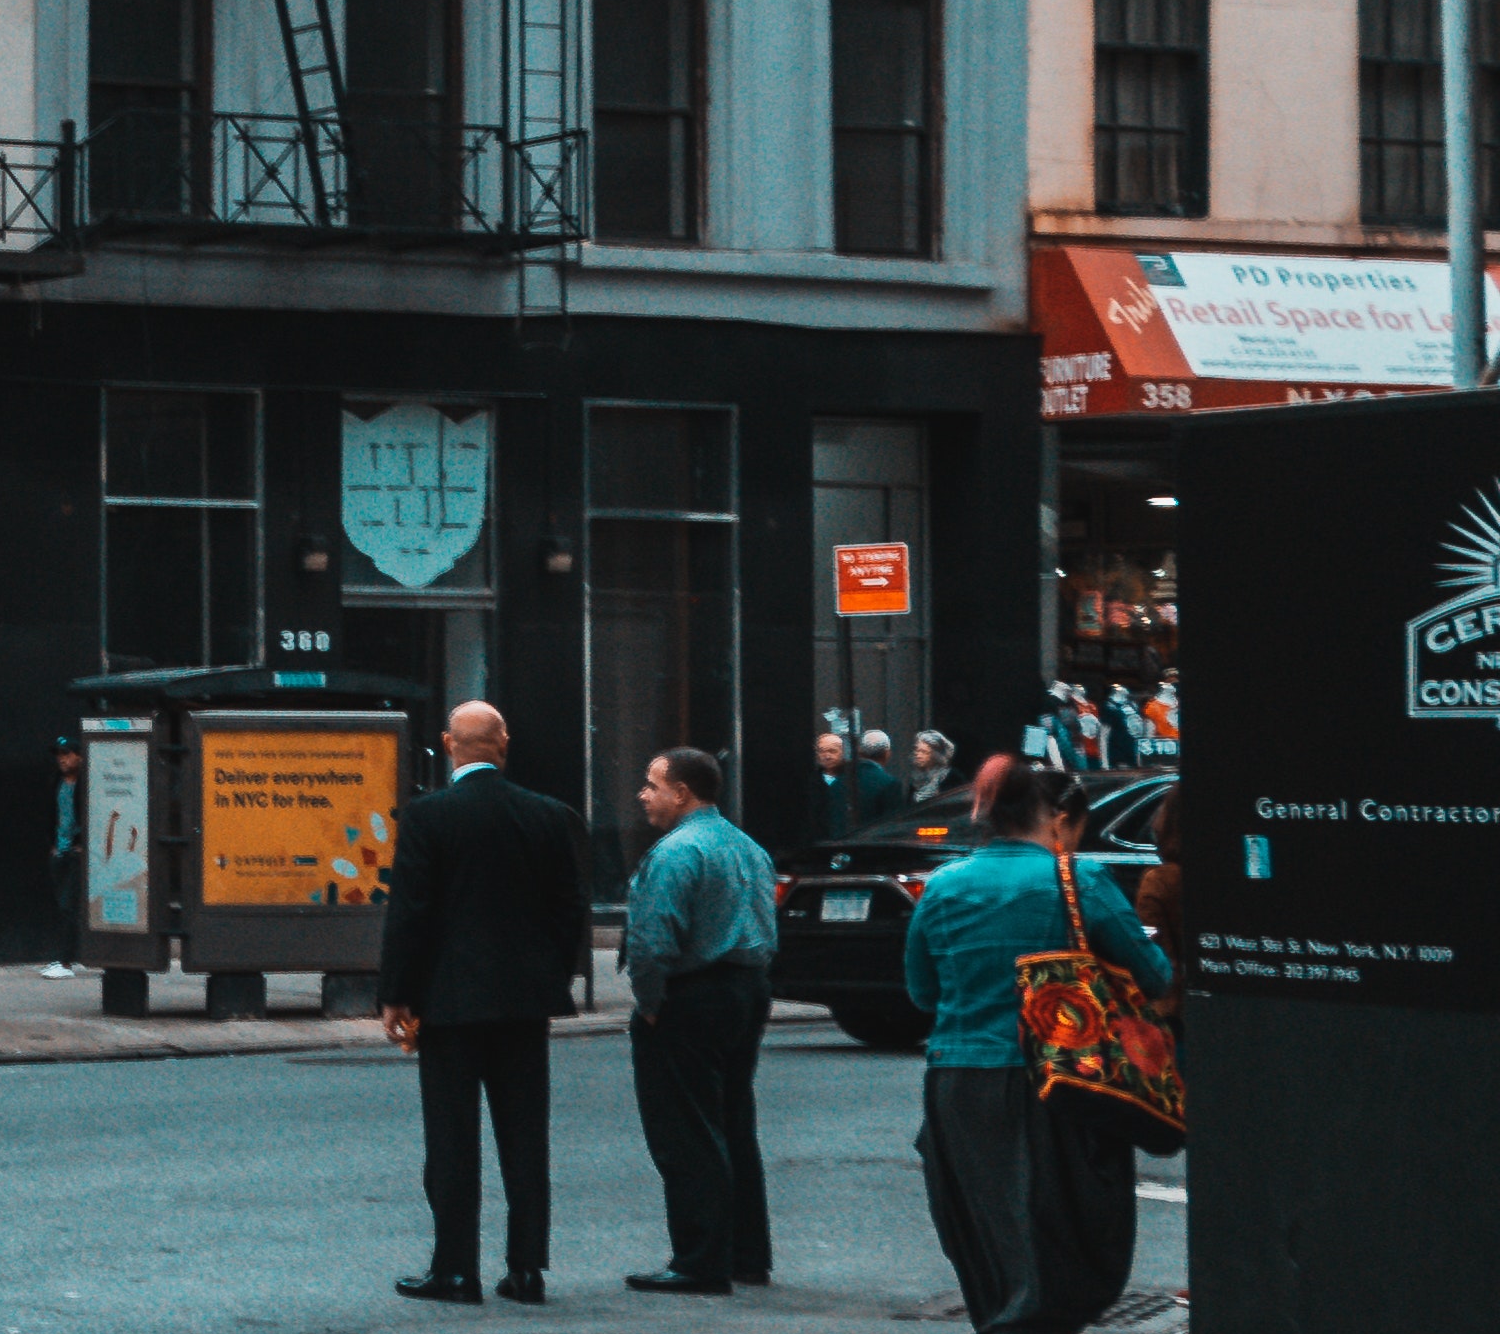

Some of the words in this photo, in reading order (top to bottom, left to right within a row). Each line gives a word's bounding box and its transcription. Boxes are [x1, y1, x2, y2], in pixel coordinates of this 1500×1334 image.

[1232, 264, 1270, 287] PD
[1275, 265, 1420, 294] Properties
[1166, 297, 1265, 328] Retail
[1266, 300, 1363, 335] Space
[1365, 303, 1415, 332] for
[1141, 382, 1192, 409] 358
[841, 552, 857, 564] NO
[280, 630, 331, 652] 360
[215, 768, 268, 786] Deliver
[273, 770, 364, 788] everywhere
[215, 791, 230, 807] in
[233, 792, 268, 808] NYC
[272, 791, 295, 808] for
[296, 791, 334, 809] free.
[1255, 797, 1348, 820] General
[1306, 939, 1340, 957] New
[1199, 956, 1232, 975] Main
